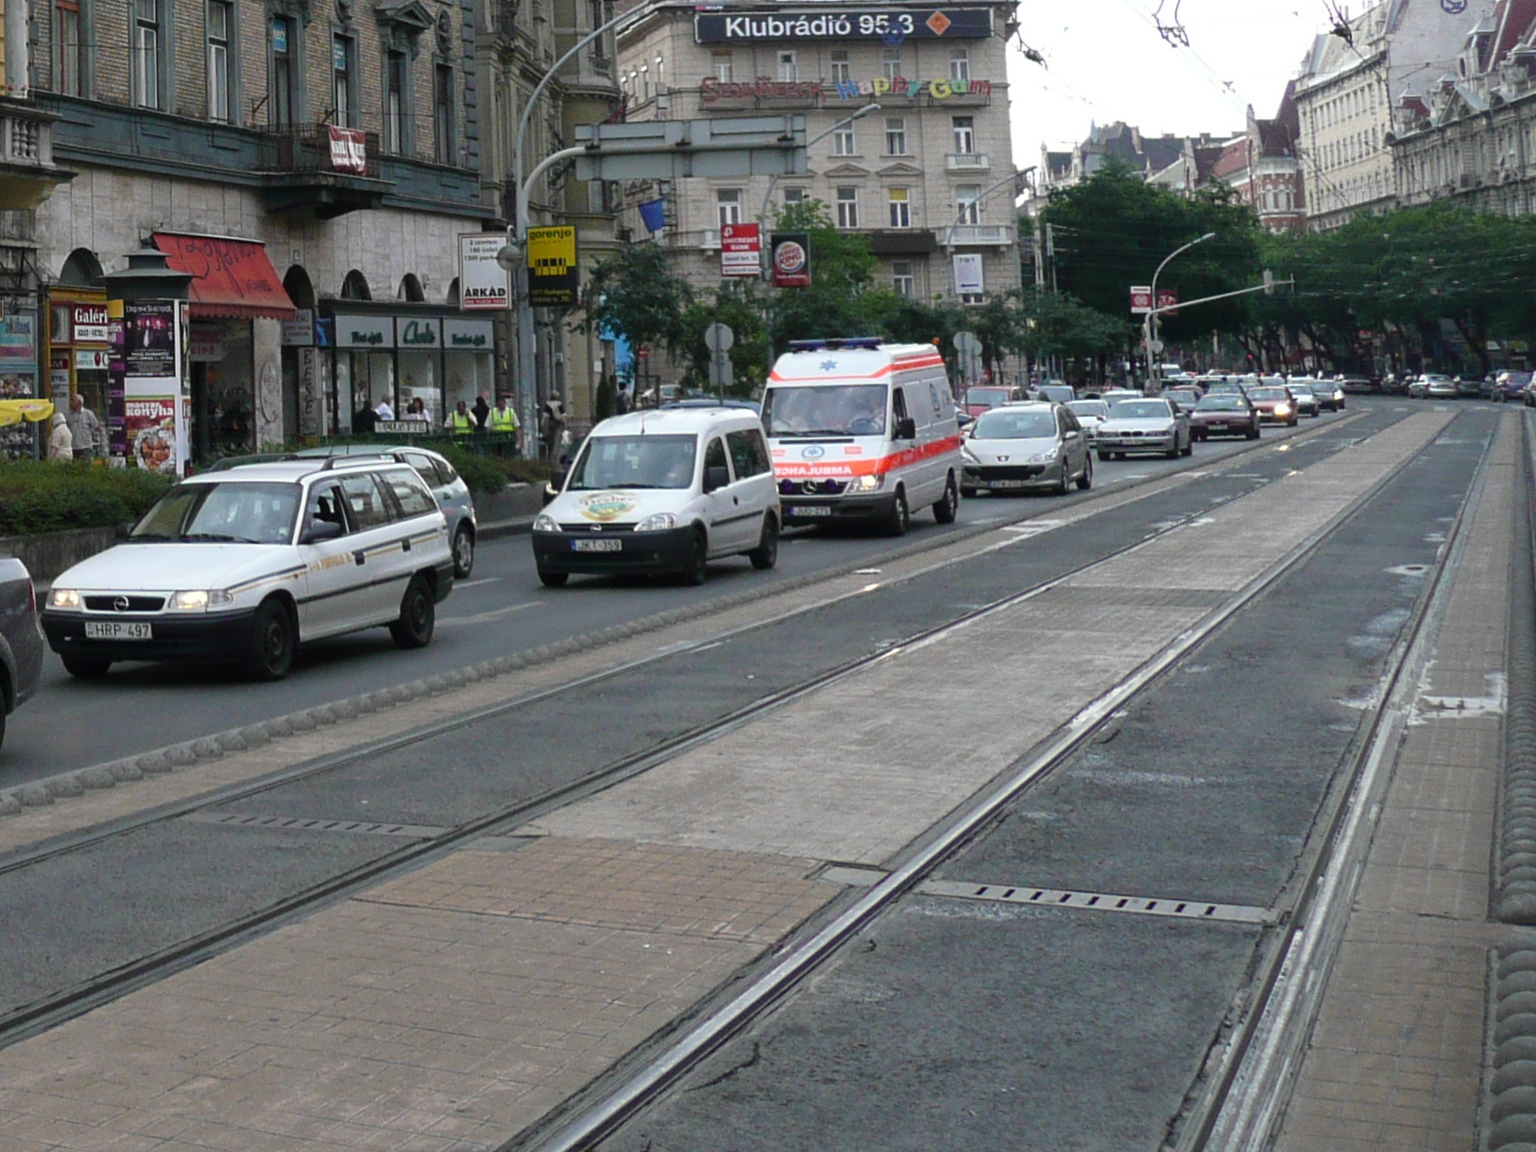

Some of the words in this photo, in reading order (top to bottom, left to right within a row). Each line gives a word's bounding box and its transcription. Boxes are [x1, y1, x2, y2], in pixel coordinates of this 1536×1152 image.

[725, 14, 851, 38] Klubrádió
[858, 14, 914, 36] 95.3
[528, 229, 572, 242] gorenje
[779, 251, 802, 265] KING
[464, 285, 506, 298] ÁRKÁD
[126, 407, 174, 420] konyha
